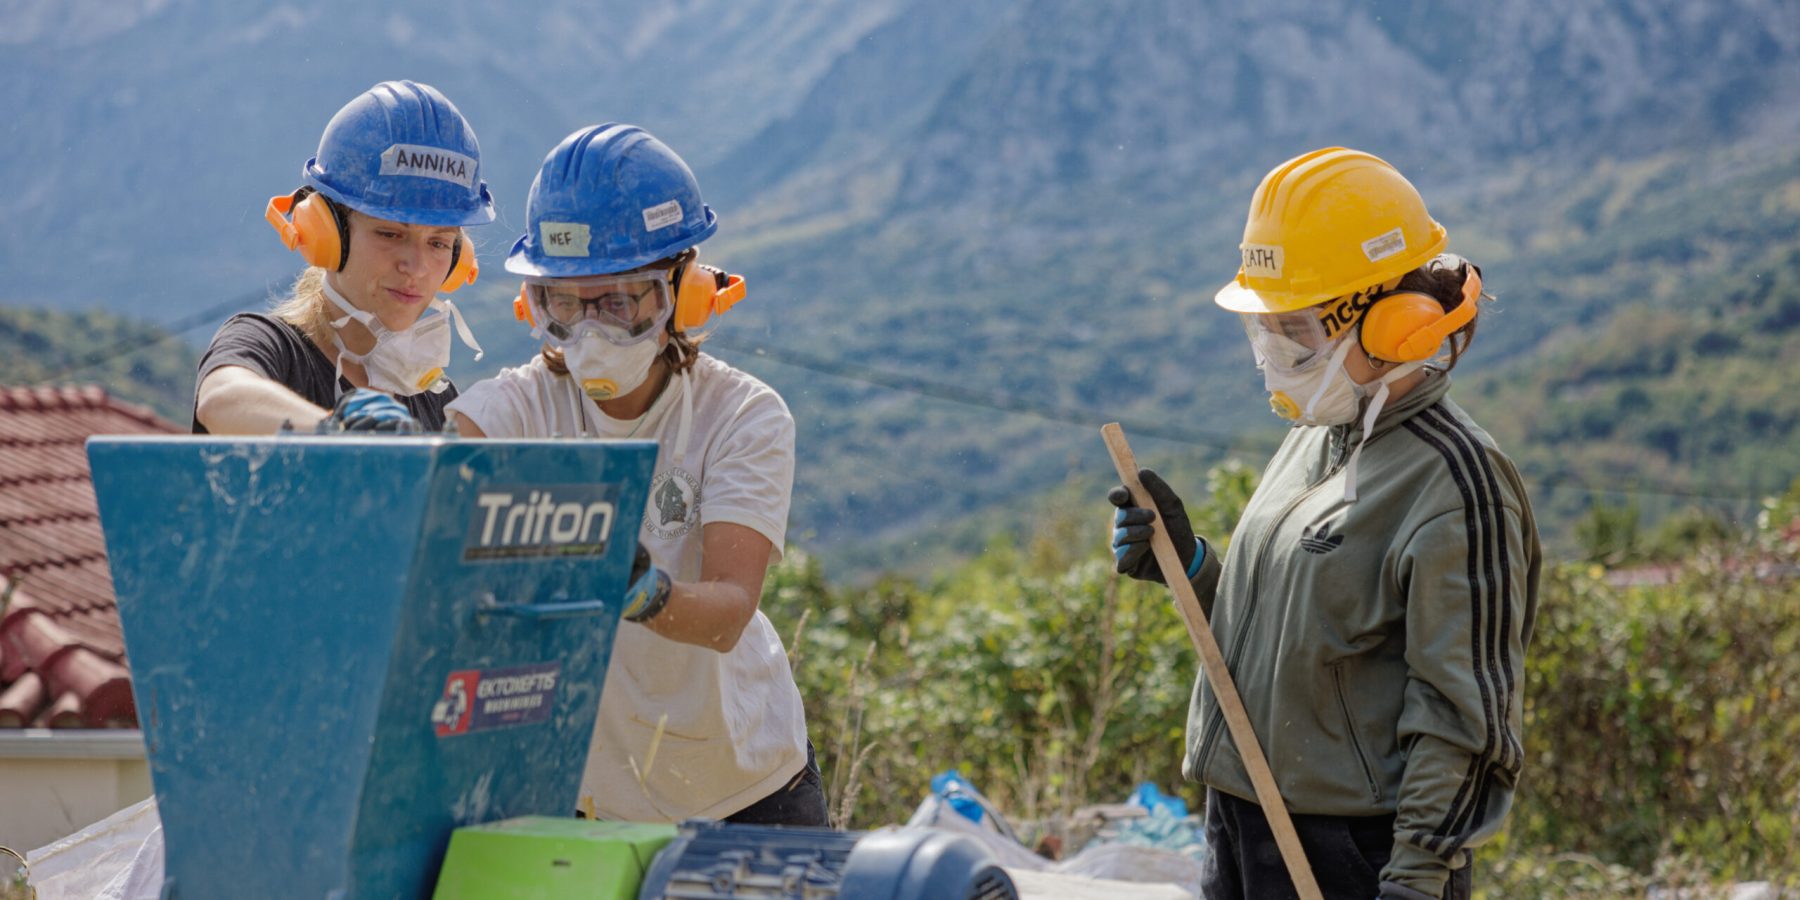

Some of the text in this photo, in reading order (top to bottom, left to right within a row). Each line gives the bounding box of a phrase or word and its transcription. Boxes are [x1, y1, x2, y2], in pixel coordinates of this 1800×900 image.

[396, 149, 467, 180] ANNIKA
[549, 232, 572, 247] NEF
[1245, 249, 1276, 271] CATH
[477, 490, 615, 547] Triton
